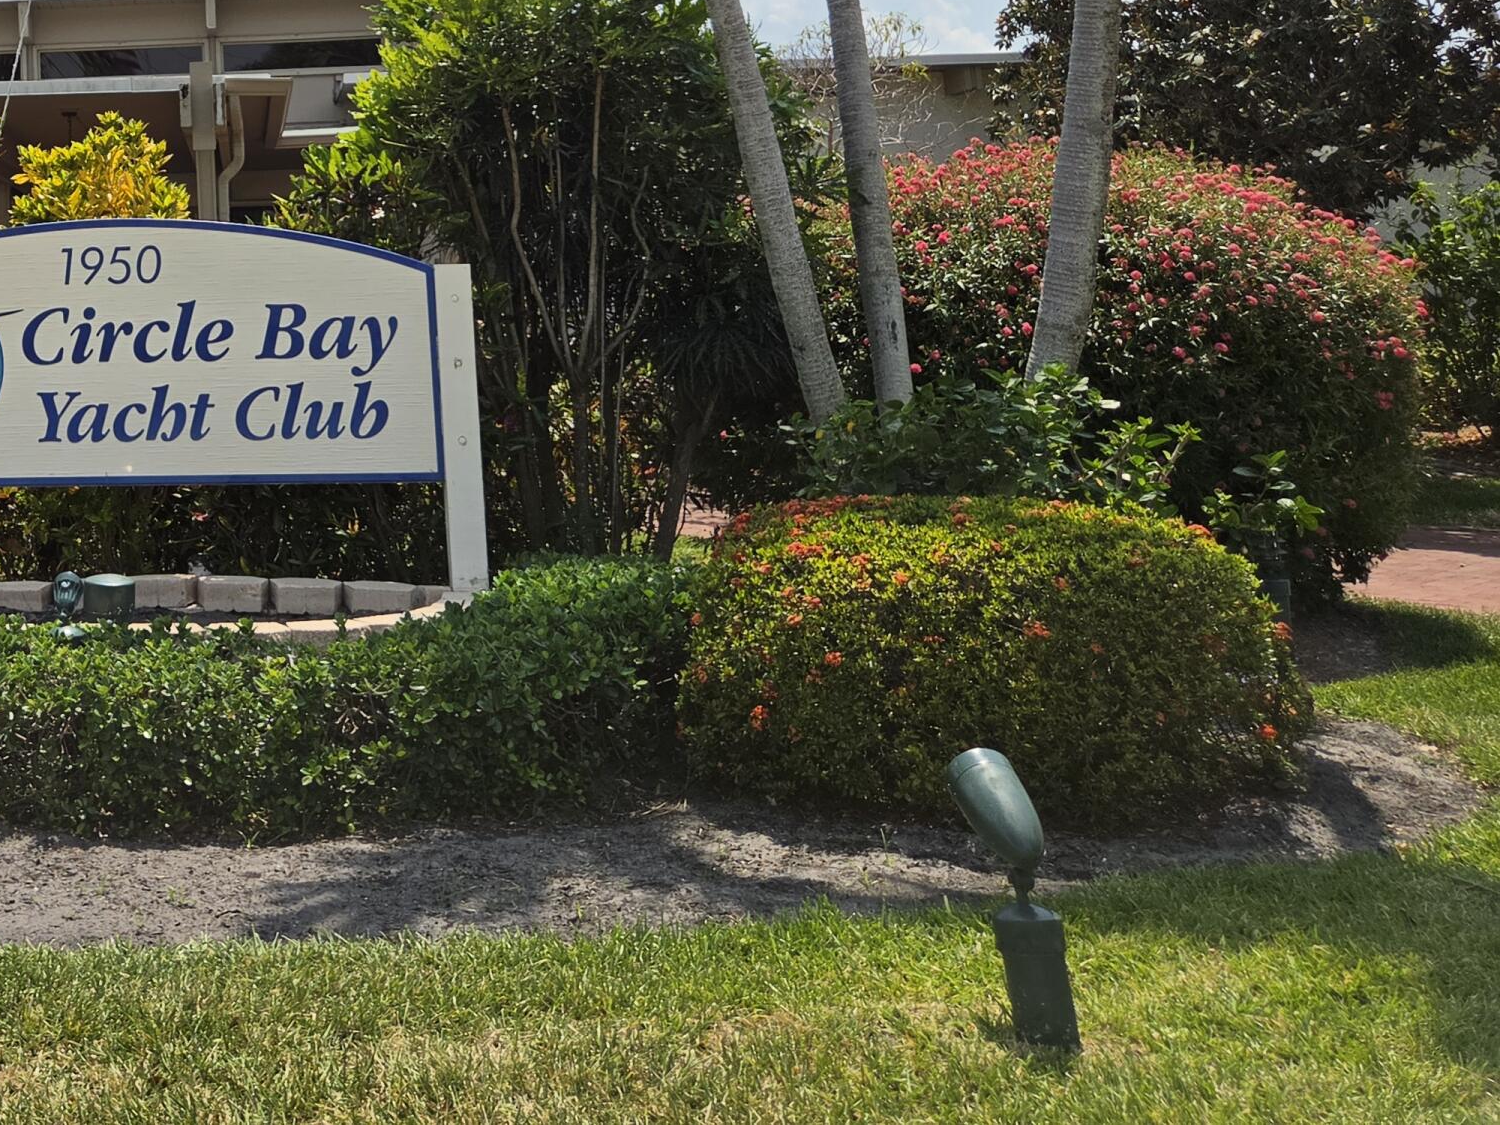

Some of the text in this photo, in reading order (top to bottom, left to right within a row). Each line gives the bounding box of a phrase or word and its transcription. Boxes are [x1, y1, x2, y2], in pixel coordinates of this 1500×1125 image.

[60, 244, 162, 286] 1950
[21, 299, 399, 378] Circle Bay
[36, 380, 390, 444] Yacht Club
